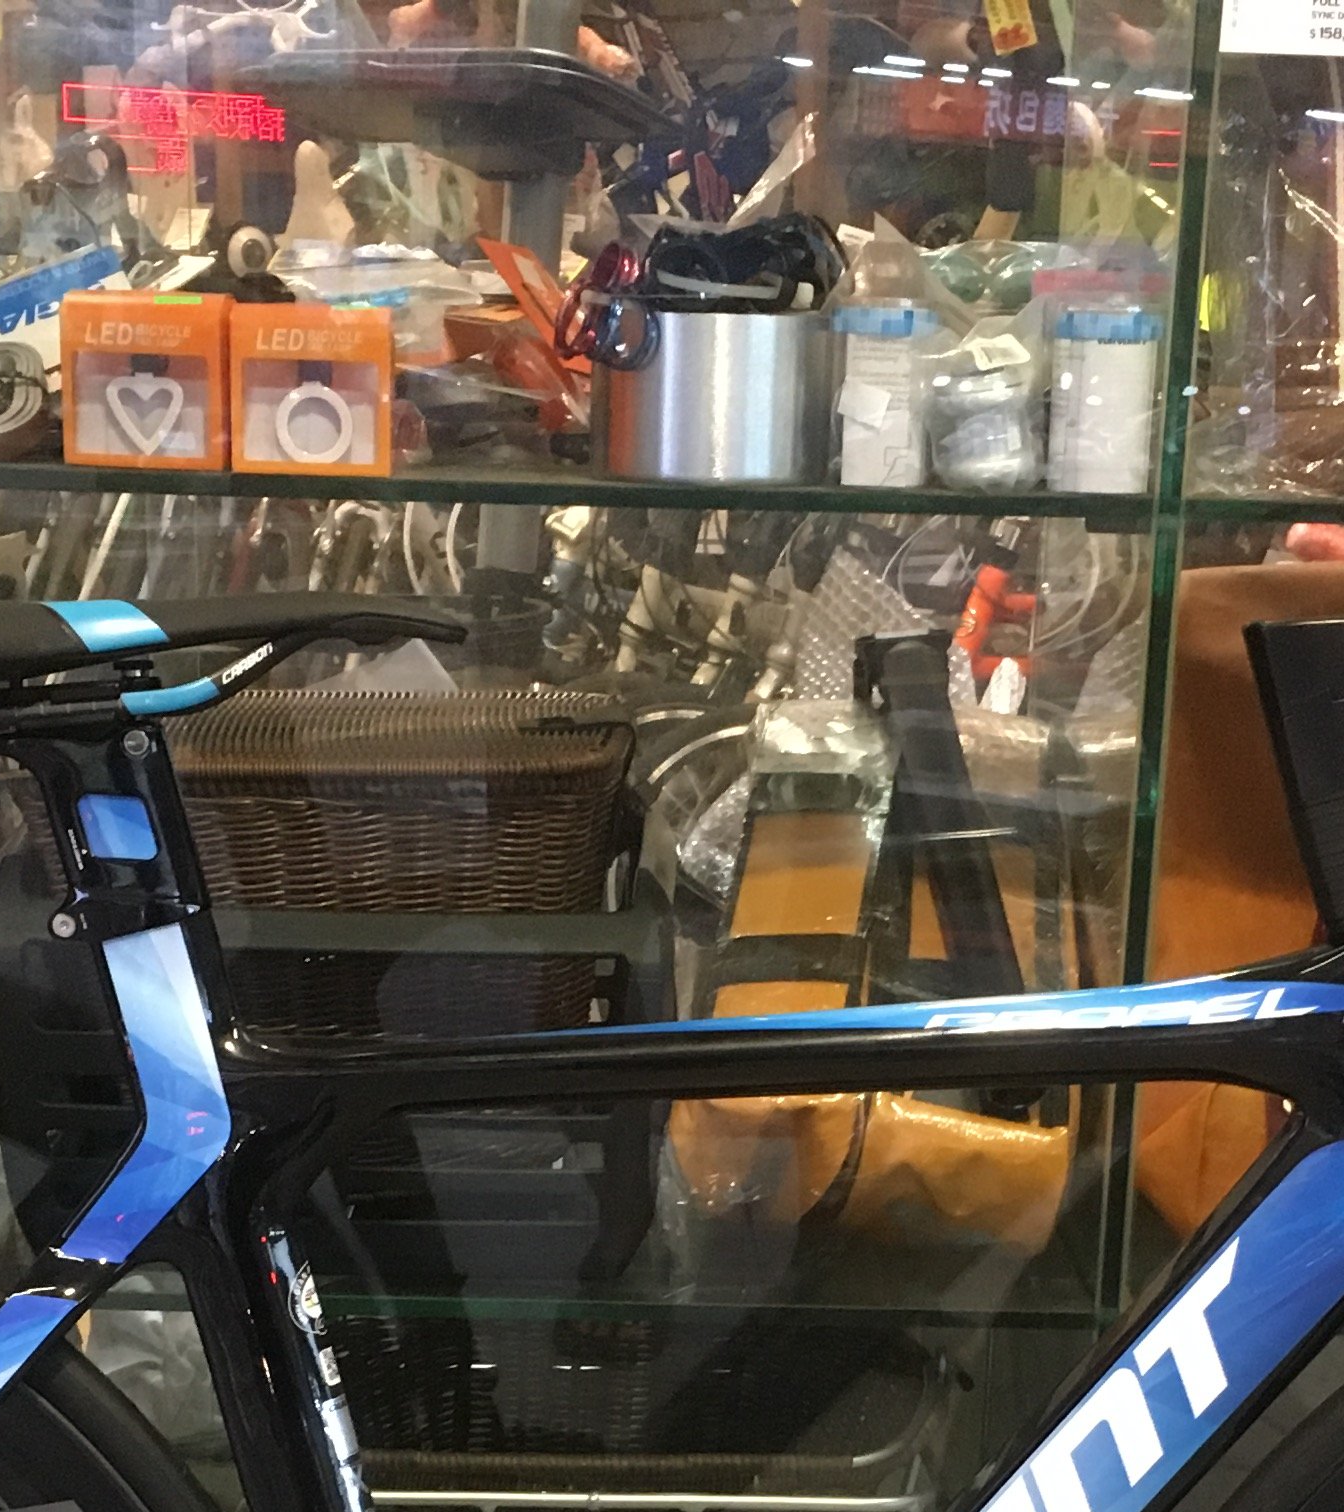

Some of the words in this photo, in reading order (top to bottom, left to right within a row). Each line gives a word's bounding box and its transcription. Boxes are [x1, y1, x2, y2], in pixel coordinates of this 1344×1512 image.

[85, 321, 133, 346] LED
[256, 327, 304, 352] LED
[220, 640, 274, 686] CARBON
